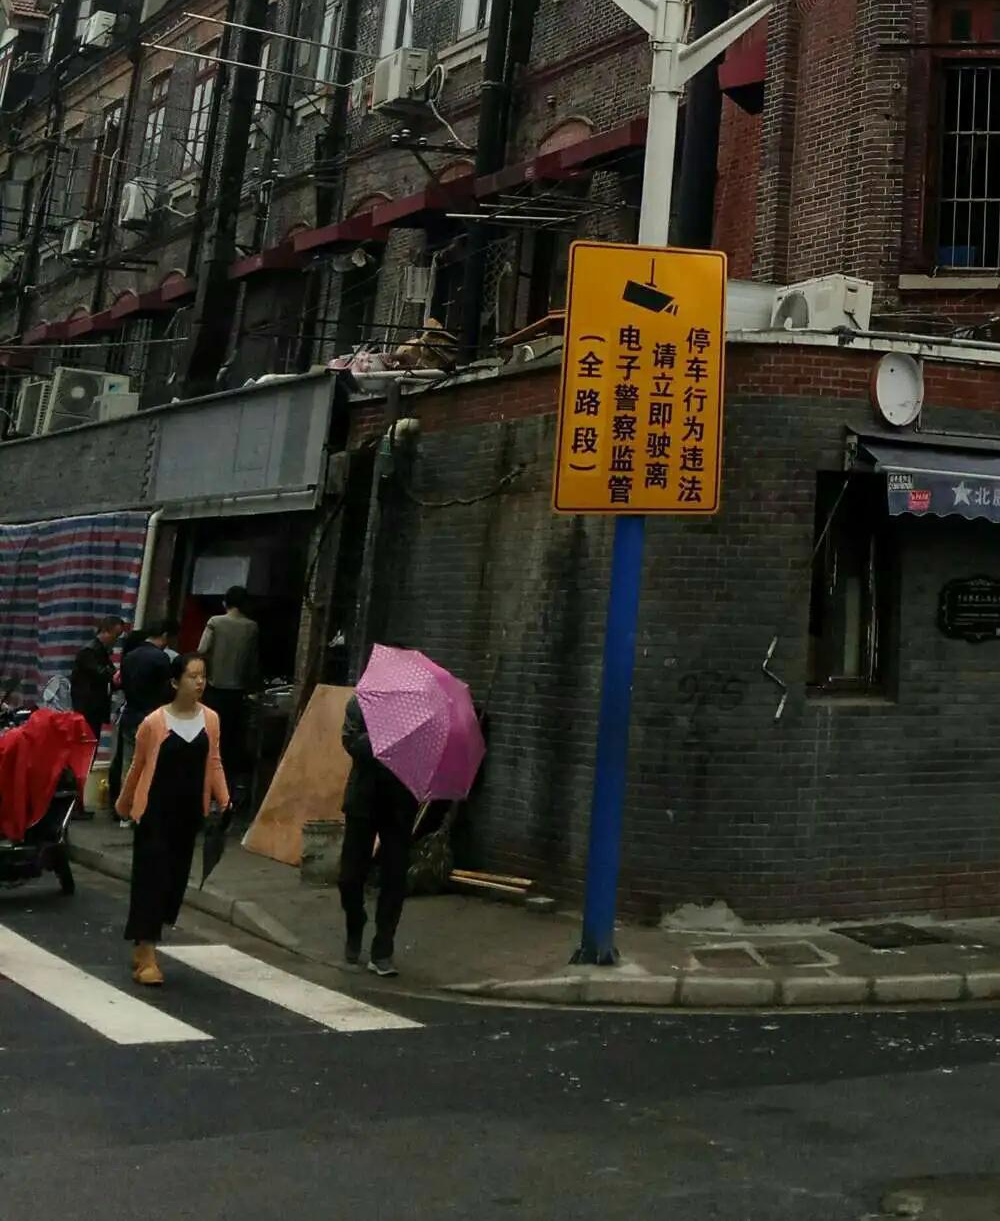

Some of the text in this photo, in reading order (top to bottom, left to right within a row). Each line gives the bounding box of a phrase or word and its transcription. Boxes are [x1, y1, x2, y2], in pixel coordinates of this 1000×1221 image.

[608, 325, 642, 504] 电子警察监管
[644, 342, 677, 490] 请立即驶离
[677, 327, 711, 503] 停车行为违法
